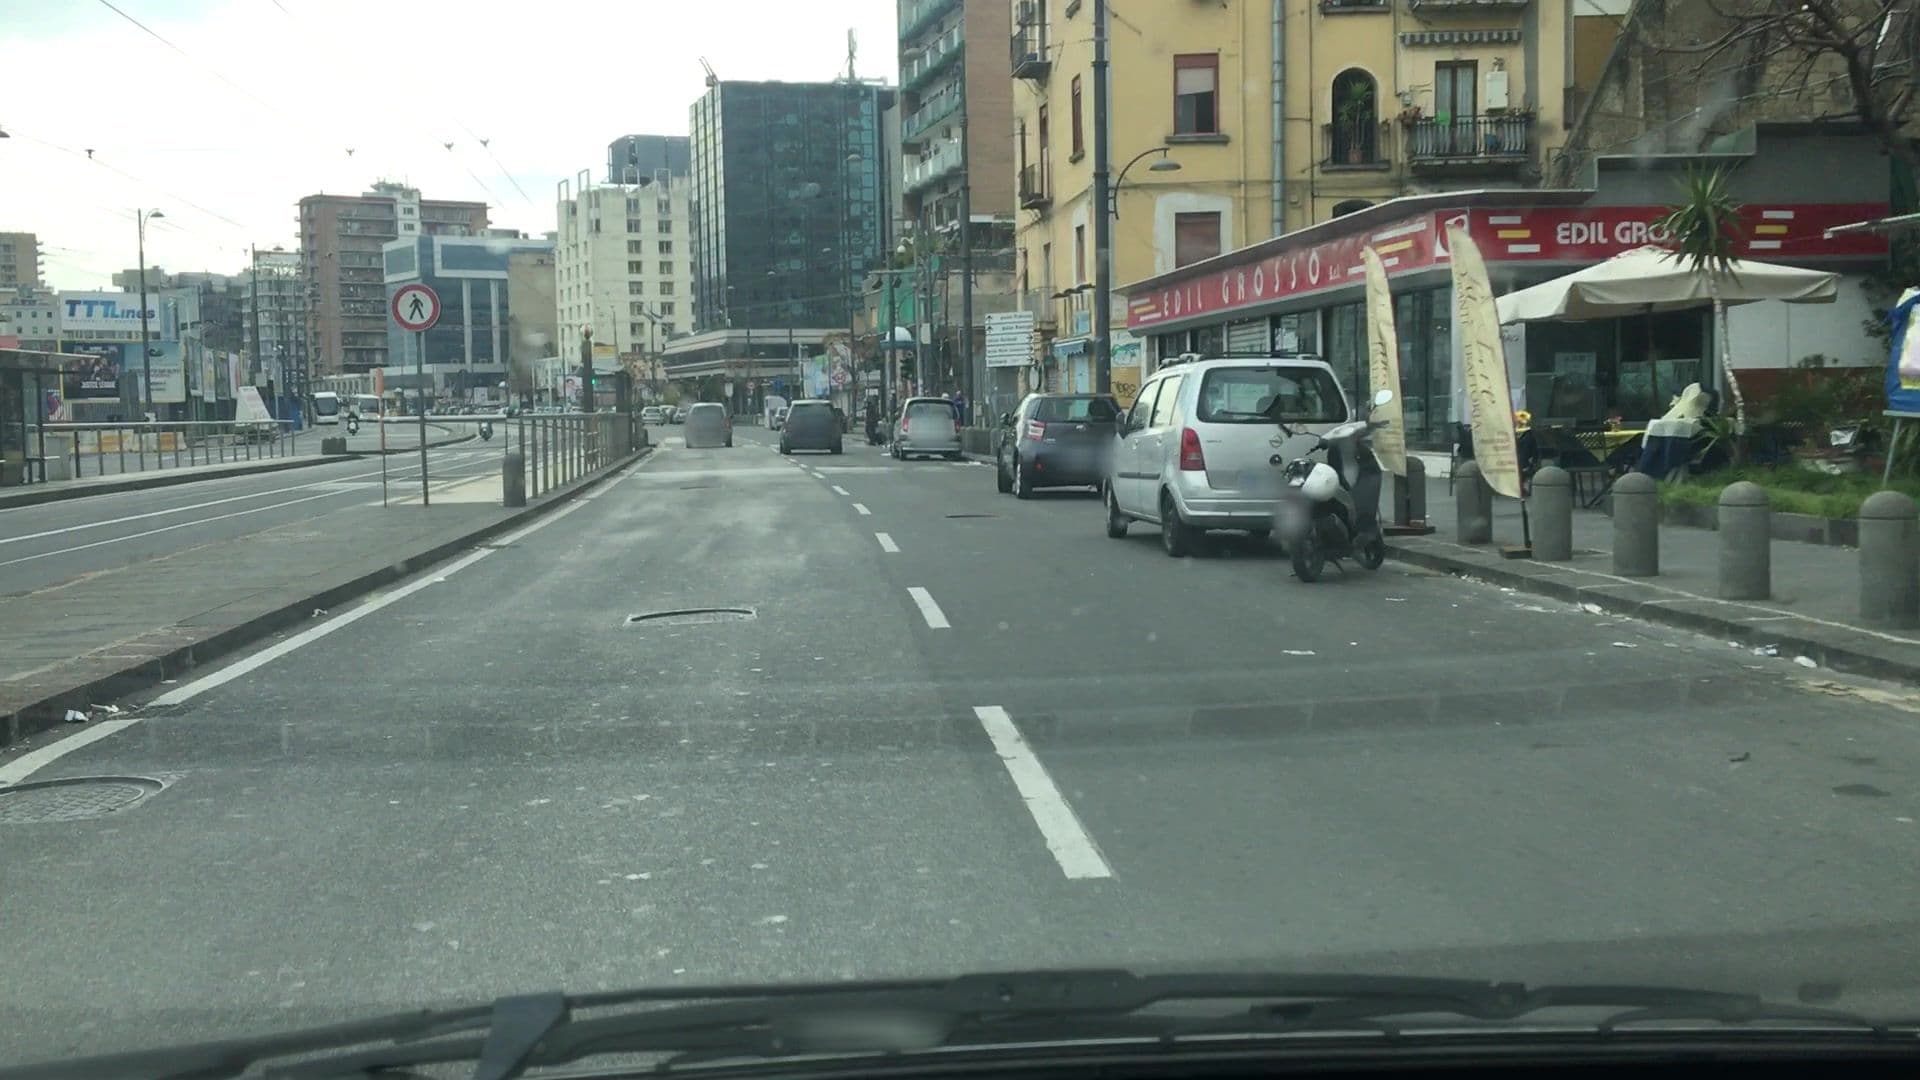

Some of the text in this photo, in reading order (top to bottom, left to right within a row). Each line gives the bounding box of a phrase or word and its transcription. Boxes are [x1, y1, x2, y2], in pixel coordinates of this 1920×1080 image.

[1556, 221, 1671, 245] EDIL GRO
[1163, 283, 1203, 317] EDIL
[1221, 249, 1320, 305] GROSSO
